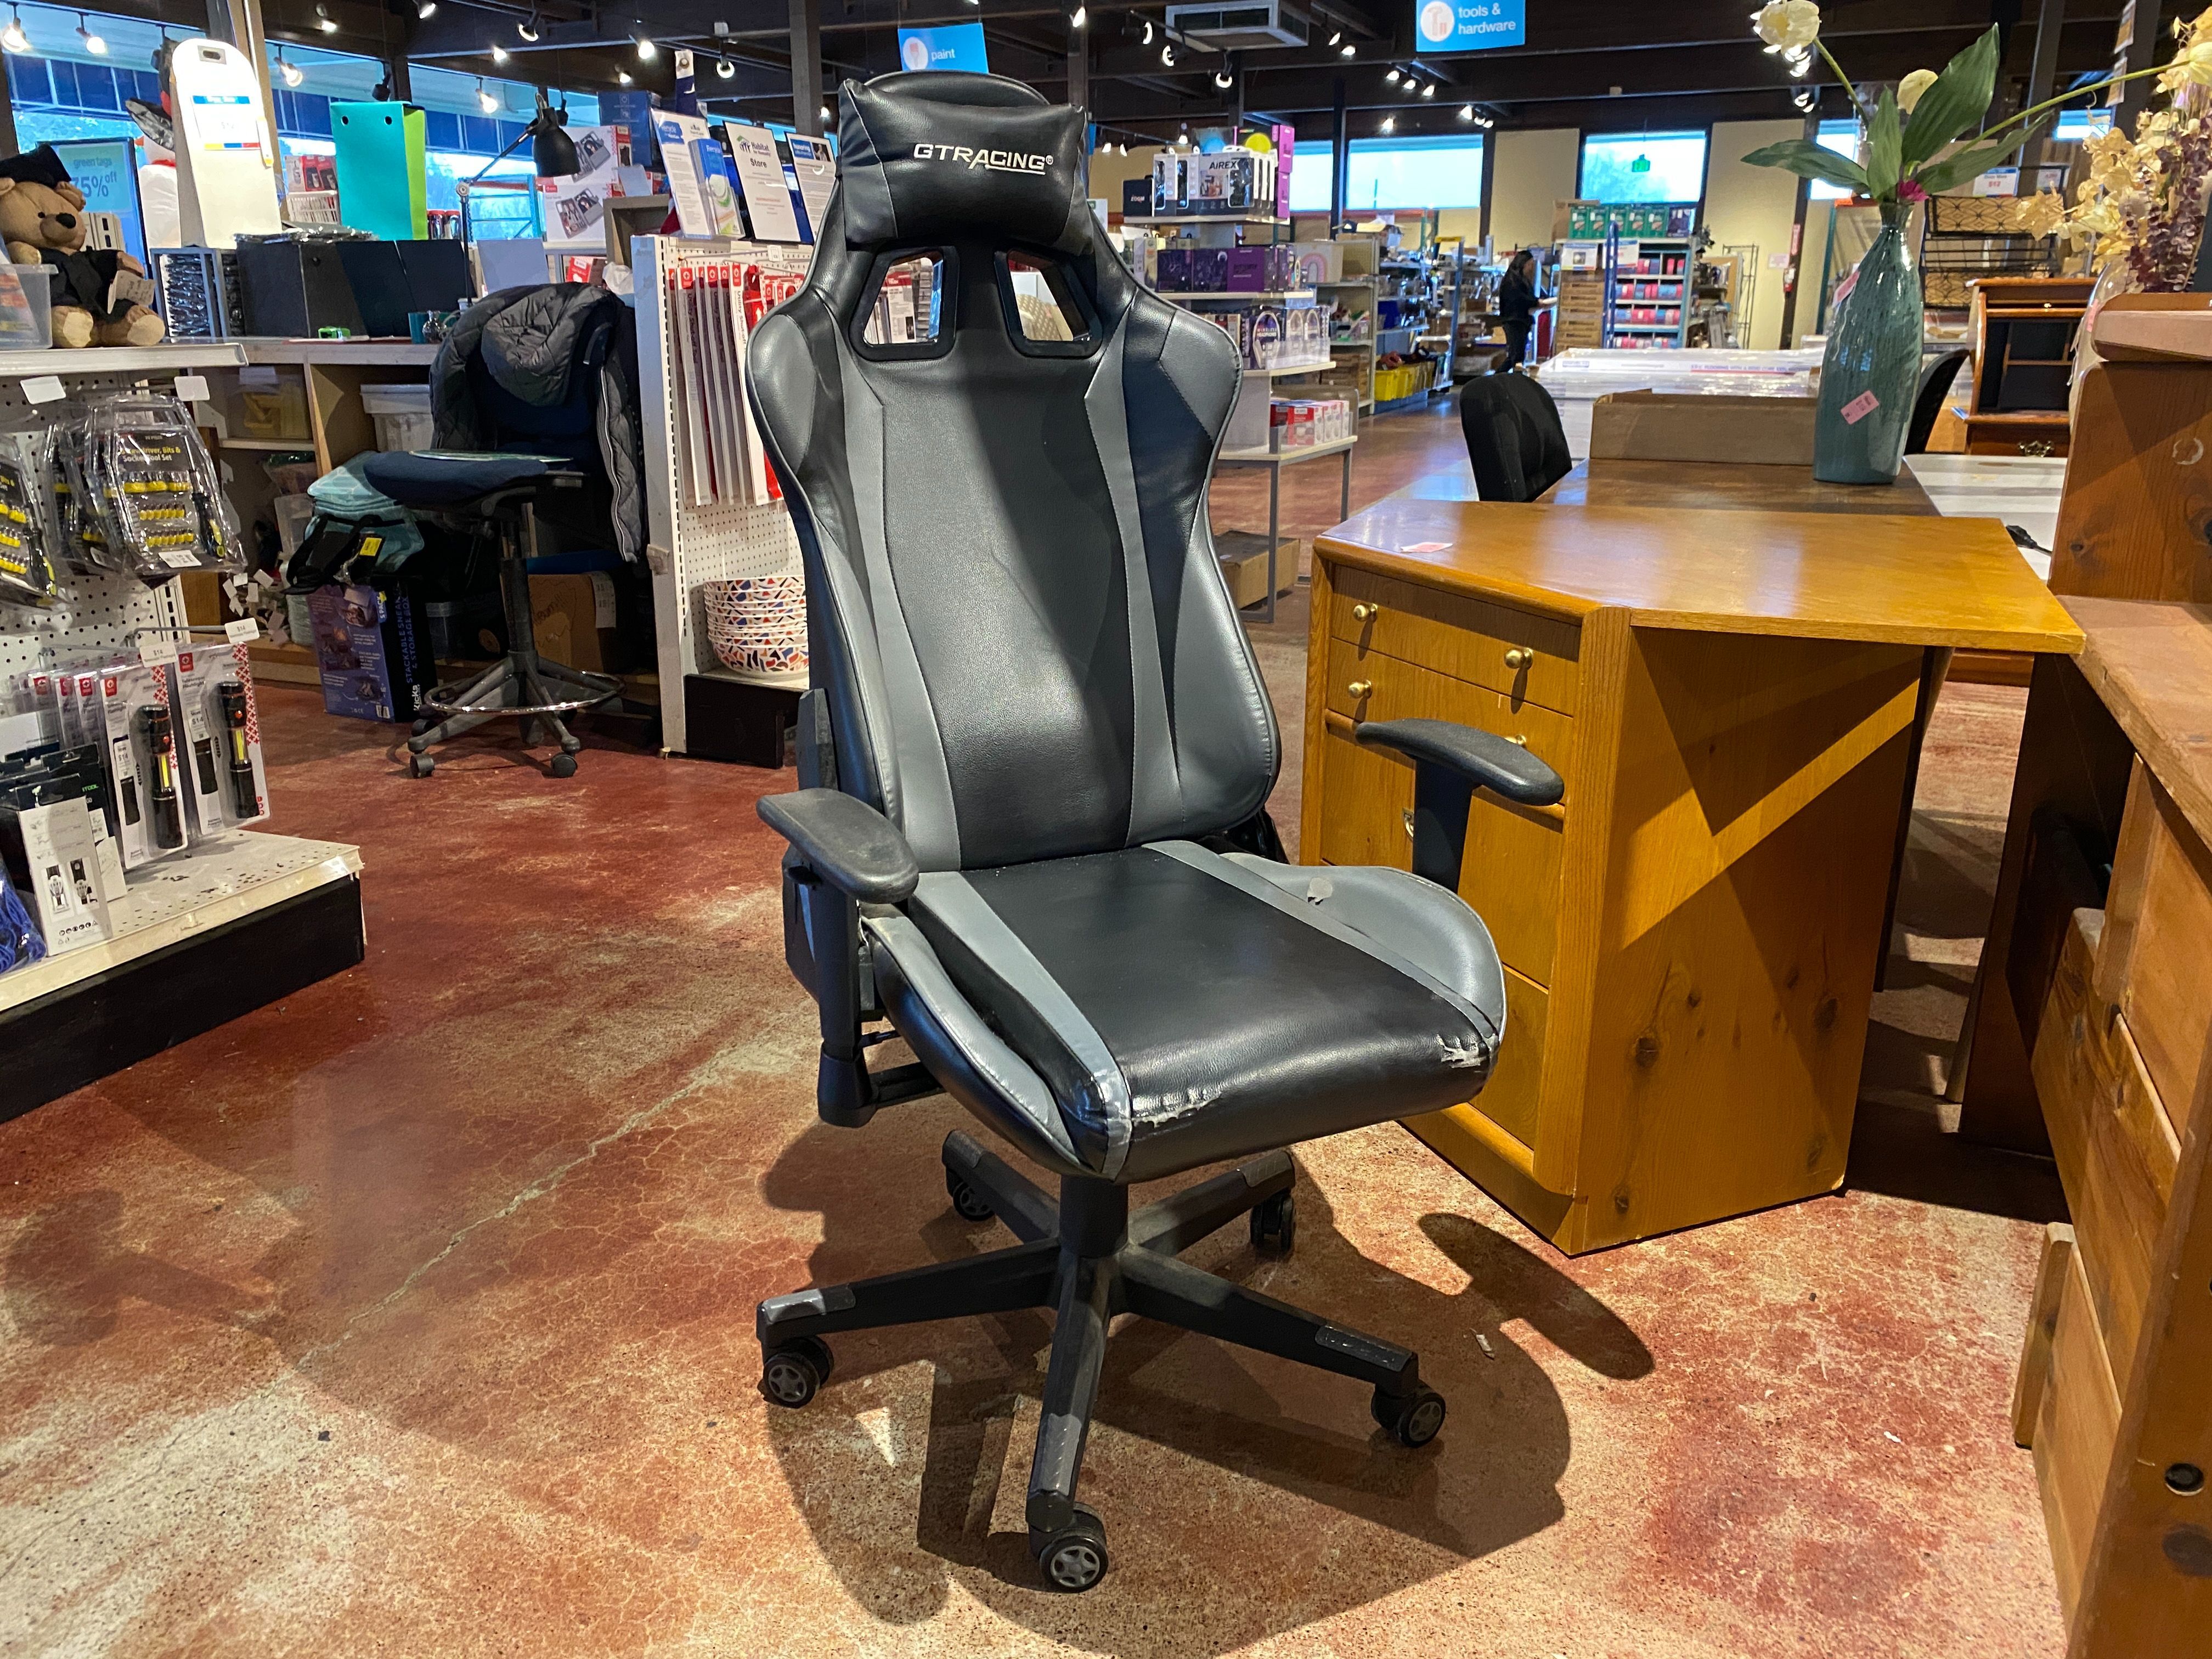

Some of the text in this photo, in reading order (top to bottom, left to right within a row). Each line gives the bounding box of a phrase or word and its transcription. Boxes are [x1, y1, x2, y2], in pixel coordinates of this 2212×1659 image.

[1458, 3, 1500, 18] tools &
[1458, 21, 1516, 35] hardware
[931, 48, 956, 61] paint
[752, 141, 770, 151] Habitat
[74, 157, 112, 169] green tags
[751, 158, 767, 168] Store
[104, 171, 117, 183] off
[405, 618, 416, 662] STORAGE
[399, 631, 413, 684] STACKABLE
